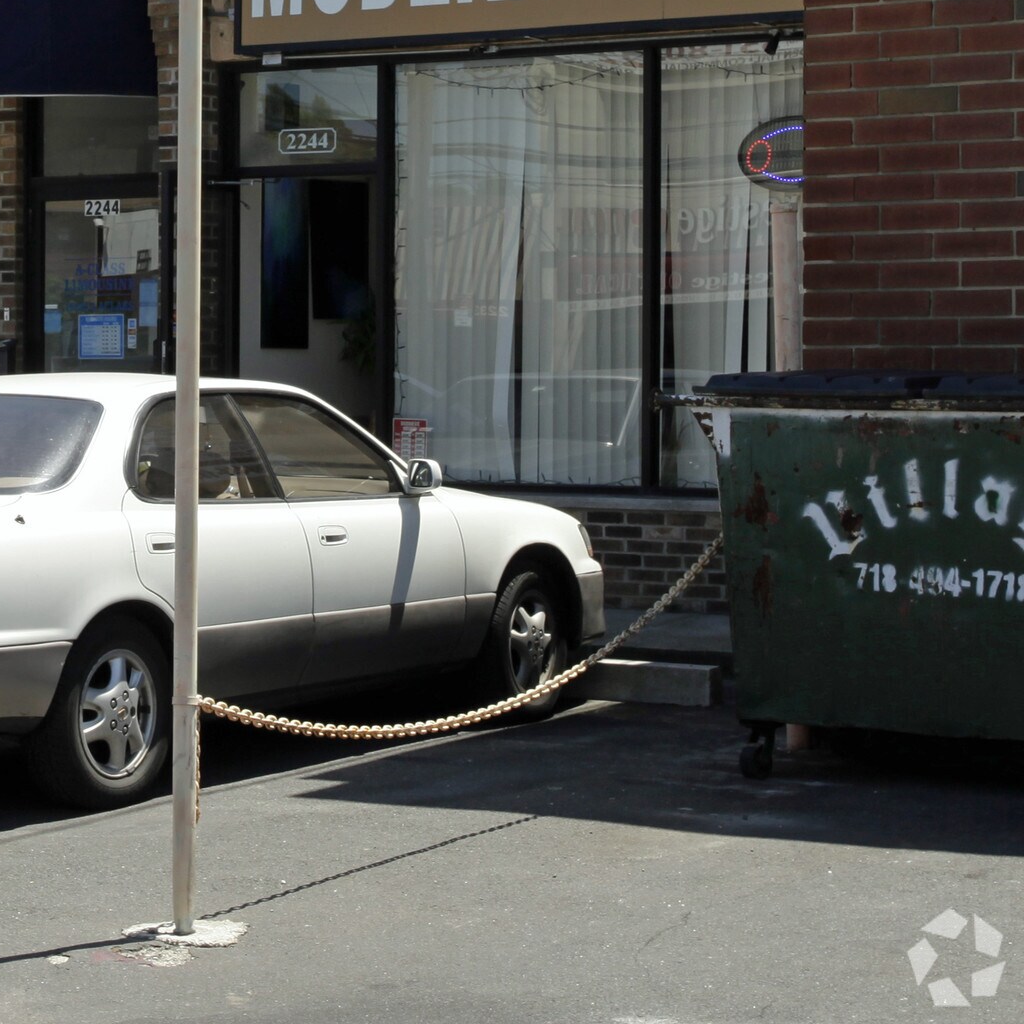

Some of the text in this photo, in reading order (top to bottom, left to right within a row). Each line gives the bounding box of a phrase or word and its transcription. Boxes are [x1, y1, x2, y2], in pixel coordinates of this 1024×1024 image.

[286, 132, 328, 150] 2244
[85, 200, 120, 216] 2244
[854, 562, 898, 593] 718
